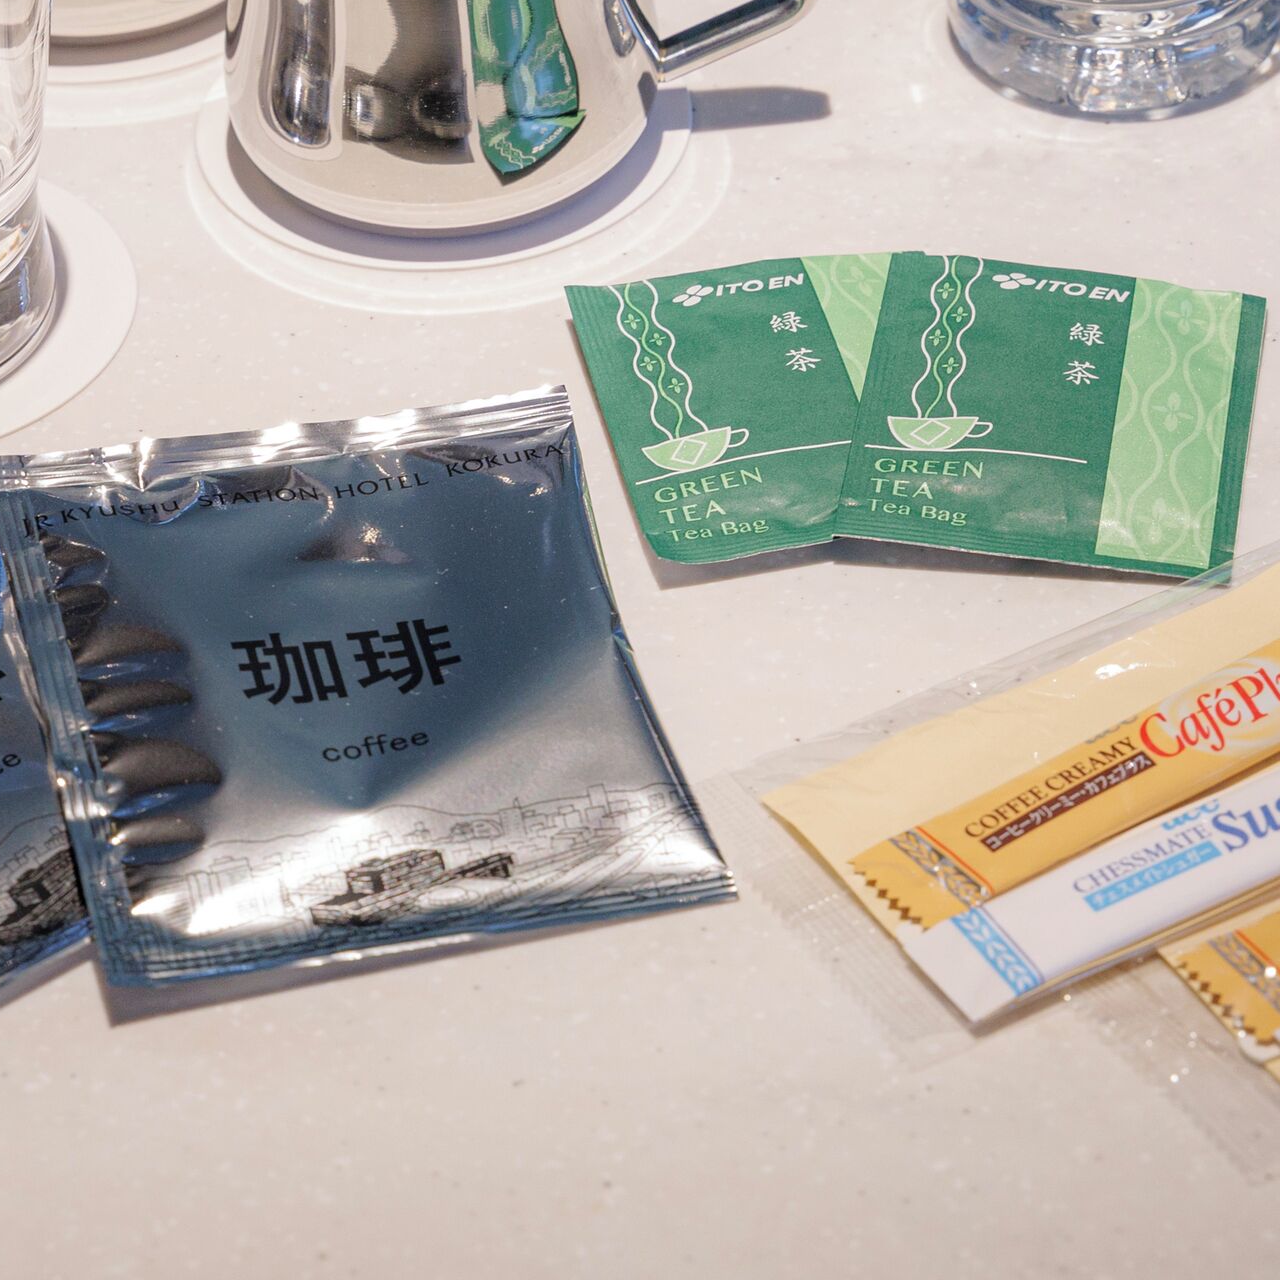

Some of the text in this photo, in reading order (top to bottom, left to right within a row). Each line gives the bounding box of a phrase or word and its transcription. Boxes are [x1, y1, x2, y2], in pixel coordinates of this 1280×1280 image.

[770, 311, 821, 372] 緑茶
[1063, 322, 1105, 385] 緑茶
[654, 467, 763, 502] GREEN
[874, 458, 983, 479] GREEN
[23, 444, 565, 538] JR KYUSHU STATION HOTEL KOKURA
[870, 478, 933, 500] TEA
[659, 500, 726, 524] TEA
[867, 499, 968, 526] Tea Bag
[666, 520, 769, 542] Tea Bag
[231, 619, 461, 705] 珈琲
[322, 731, 429, 763] coffee
[964, 736, 1139, 838] COFFEE CREAMY
[1073, 824, 1212, 894] CHESSMATE
